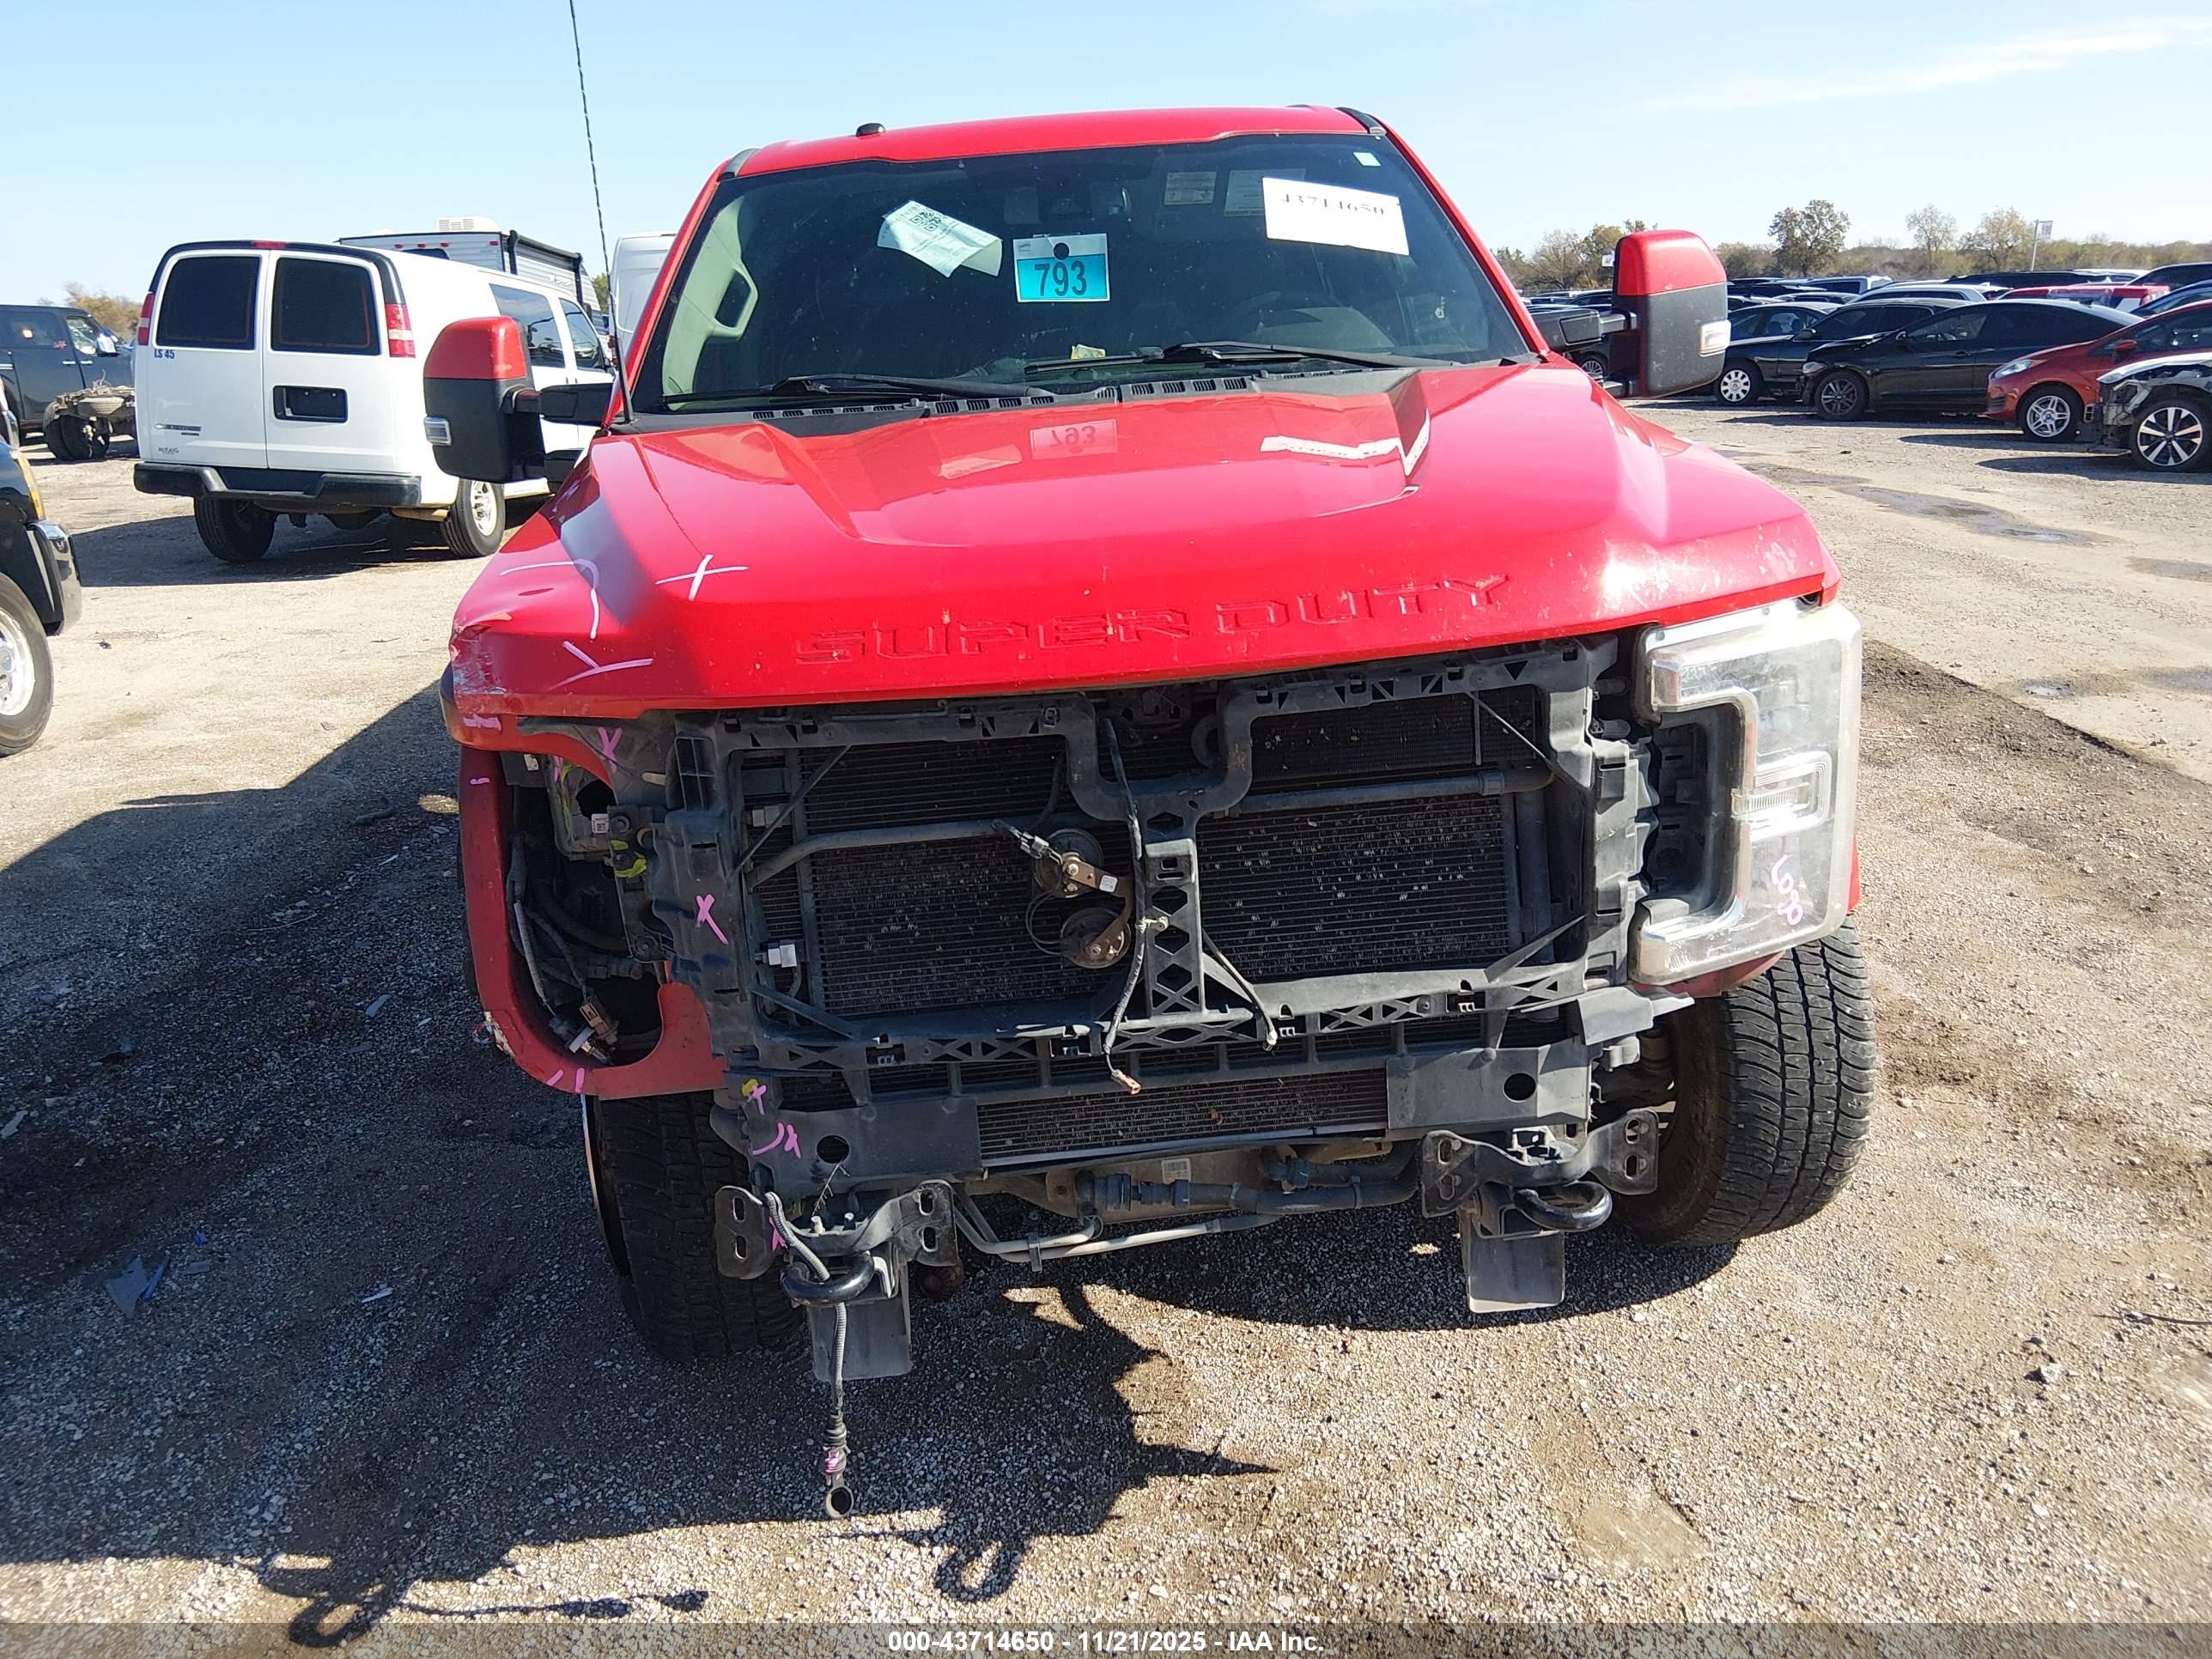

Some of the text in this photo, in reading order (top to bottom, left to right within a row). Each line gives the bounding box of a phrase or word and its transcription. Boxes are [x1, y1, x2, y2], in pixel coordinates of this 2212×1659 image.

[1035, 260, 1087, 297] 793
[164, 349, 175, 359] 45
[796, 574, 1510, 666] SUPER DUTY
